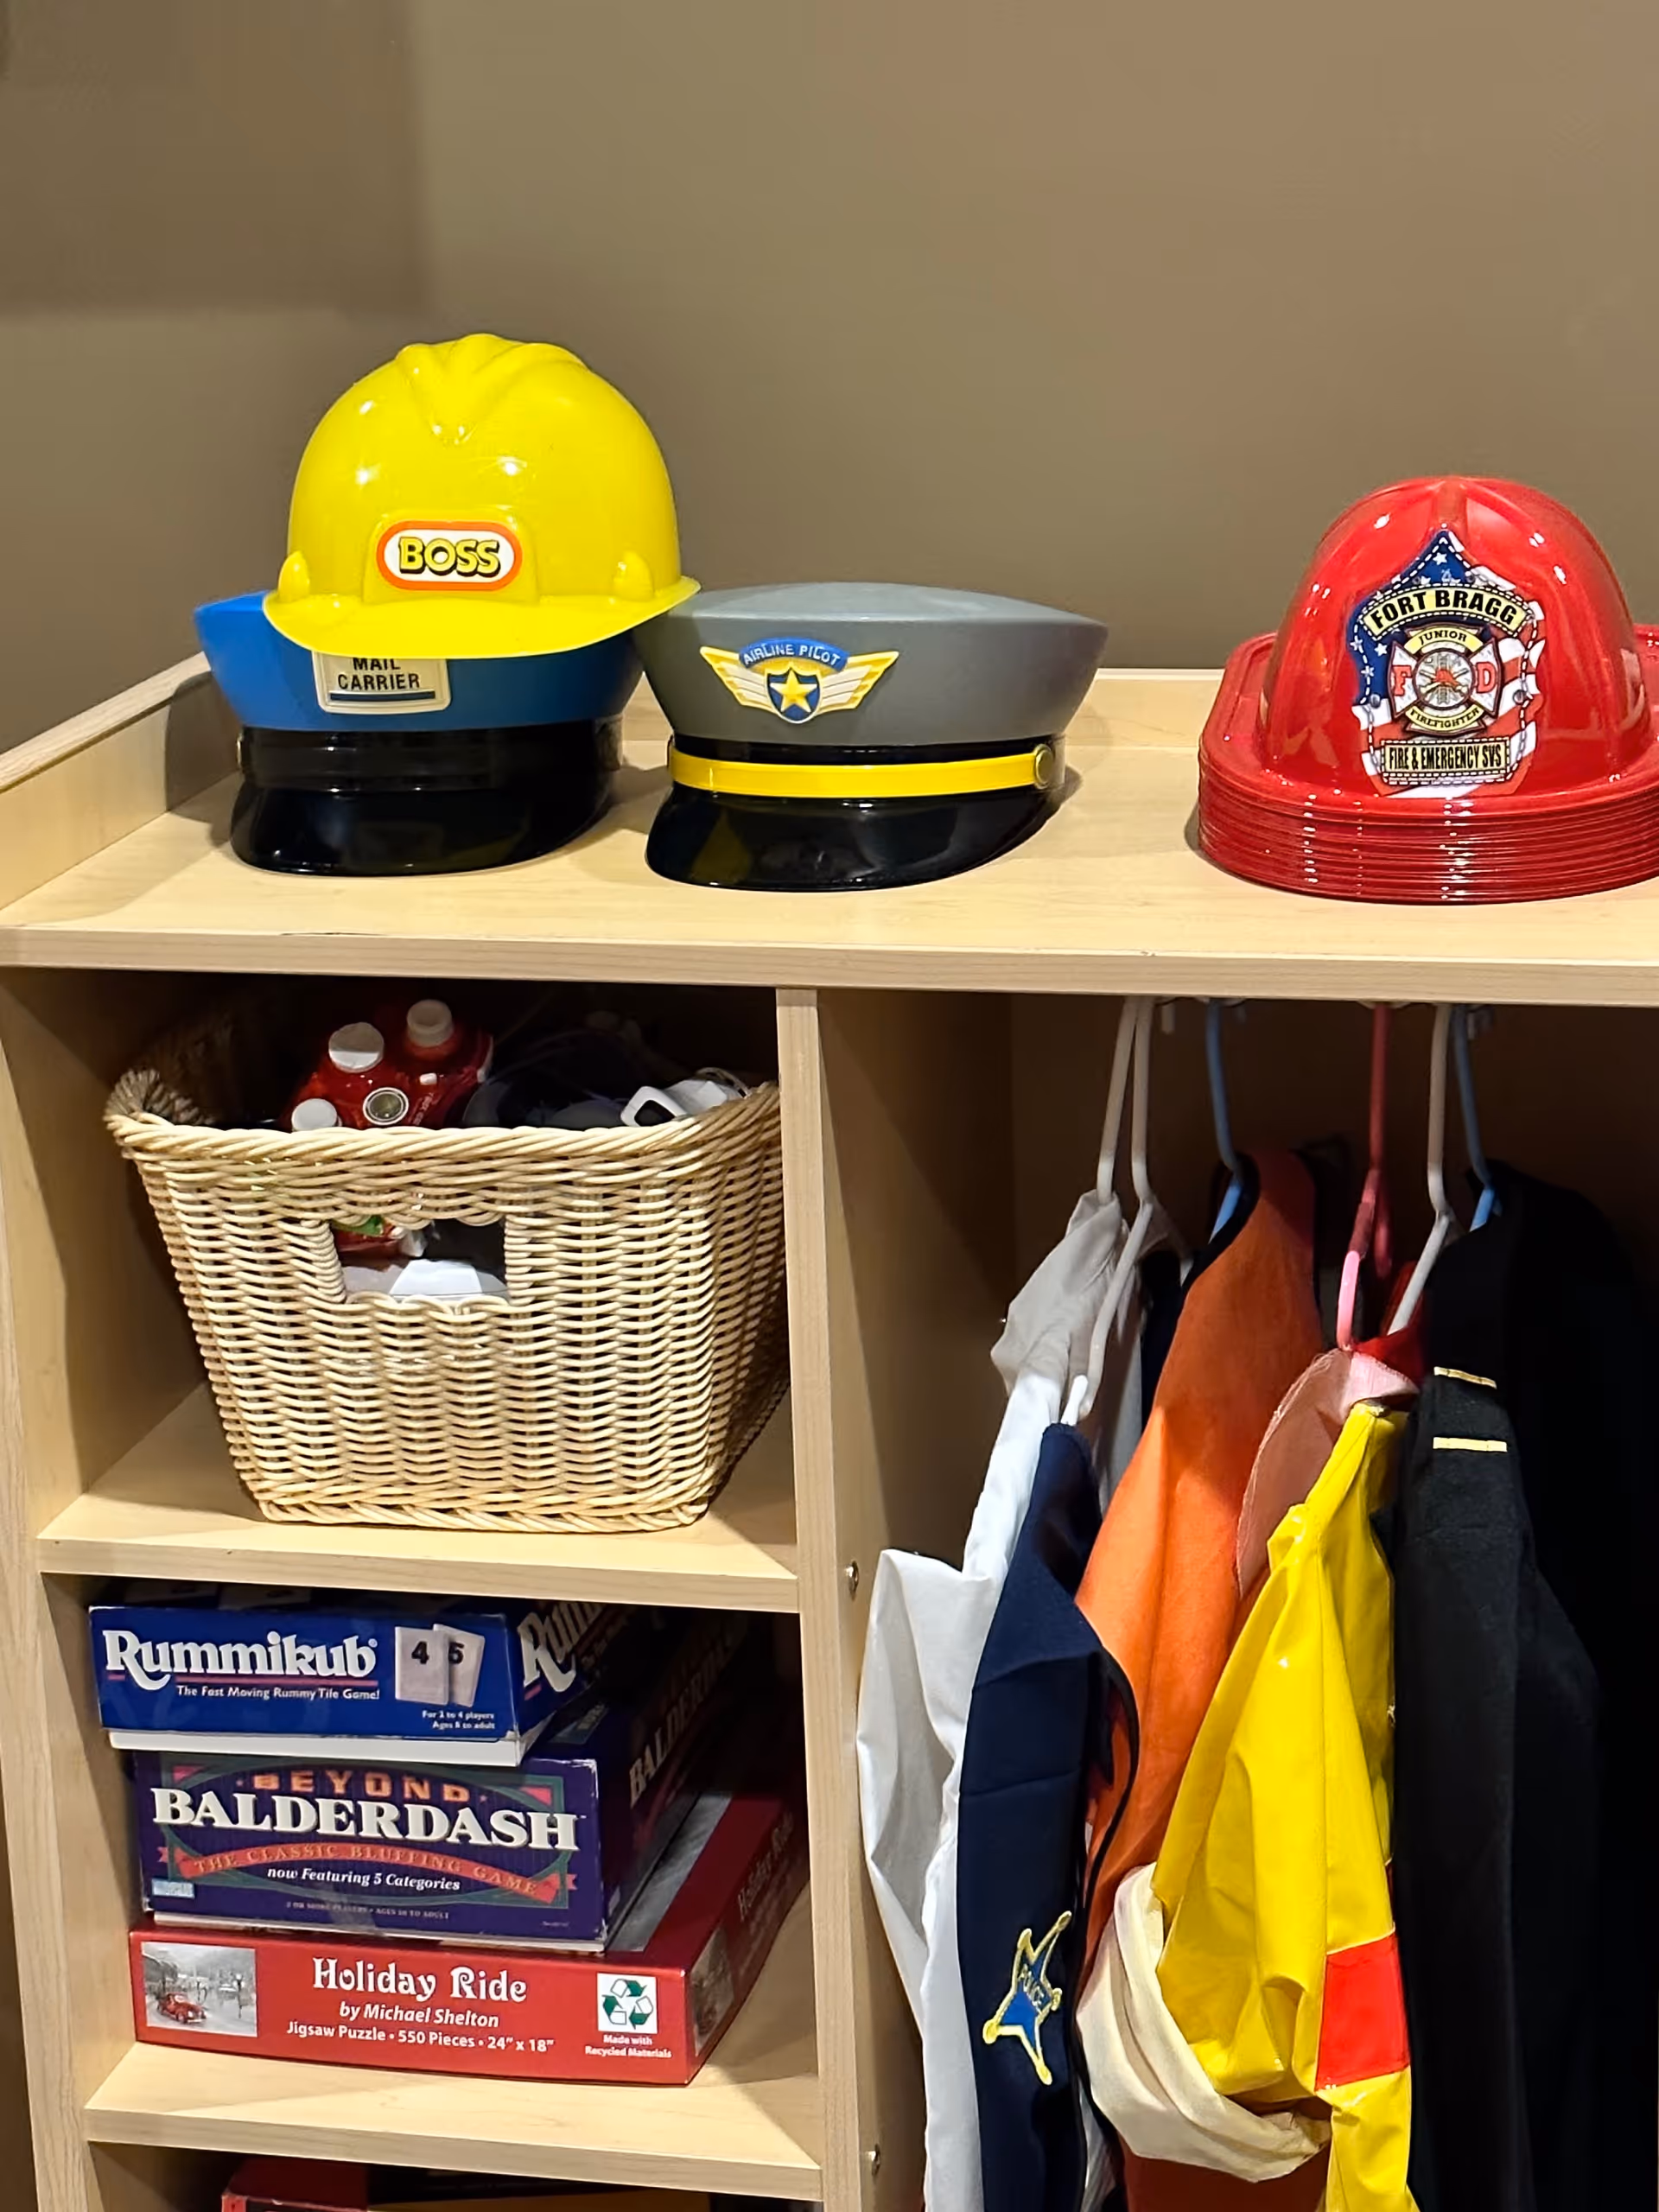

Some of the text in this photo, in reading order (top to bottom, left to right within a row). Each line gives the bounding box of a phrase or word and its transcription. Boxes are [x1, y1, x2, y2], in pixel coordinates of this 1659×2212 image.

[398, 536, 501, 578] BOSS
[1370, 590, 1517, 630] FORT BRAGG
[1418, 629, 1467, 646] JUNIOR
[352, 657, 401, 671] MAIL
[743, 643, 841, 665] AIRLINE PILOT
[337, 672, 421, 691] CARRIER
[1392, 662, 1497, 696] F D
[1409, 707, 1480, 728] FIREFIGHTER
[1389, 744, 1502, 770] FIRE & EMERGENCY SVS
[102, 1630, 377, 1691] Rummikub
[410, 1640, 430, 1665] 4
[176, 1685, 380, 1700] The Fast Moving Rummy Tile Game!
[422, 1710, 437, 1719] For
[465, 1712, 494, 1720] players
[432, 1720, 454, 1730] Ages
[253, 1770, 470, 1803] BEYOND
[150, 1787, 581, 1851] BALDERDASH
[194, 1843, 538, 1896] THE CLASSIC BLUFFING GAME
[267, 1867, 461, 1891] now Featuring 5 Categories
[312, 1957, 527, 2003] Holiday Ride
[339, 2001, 499, 2028] by Michael Shelton
[286, 2021, 335, 2038] Jigsaw
[338, 2024, 386, 2041] Puzzle
[397, 2030, 426, 2044] 550
[429, 2032, 475, 2048] Pieces
[515, 2040, 524, 2051] x
[603, 2034, 653, 2045] Made with
[584, 2045, 672, 2058] Recycled Materials
